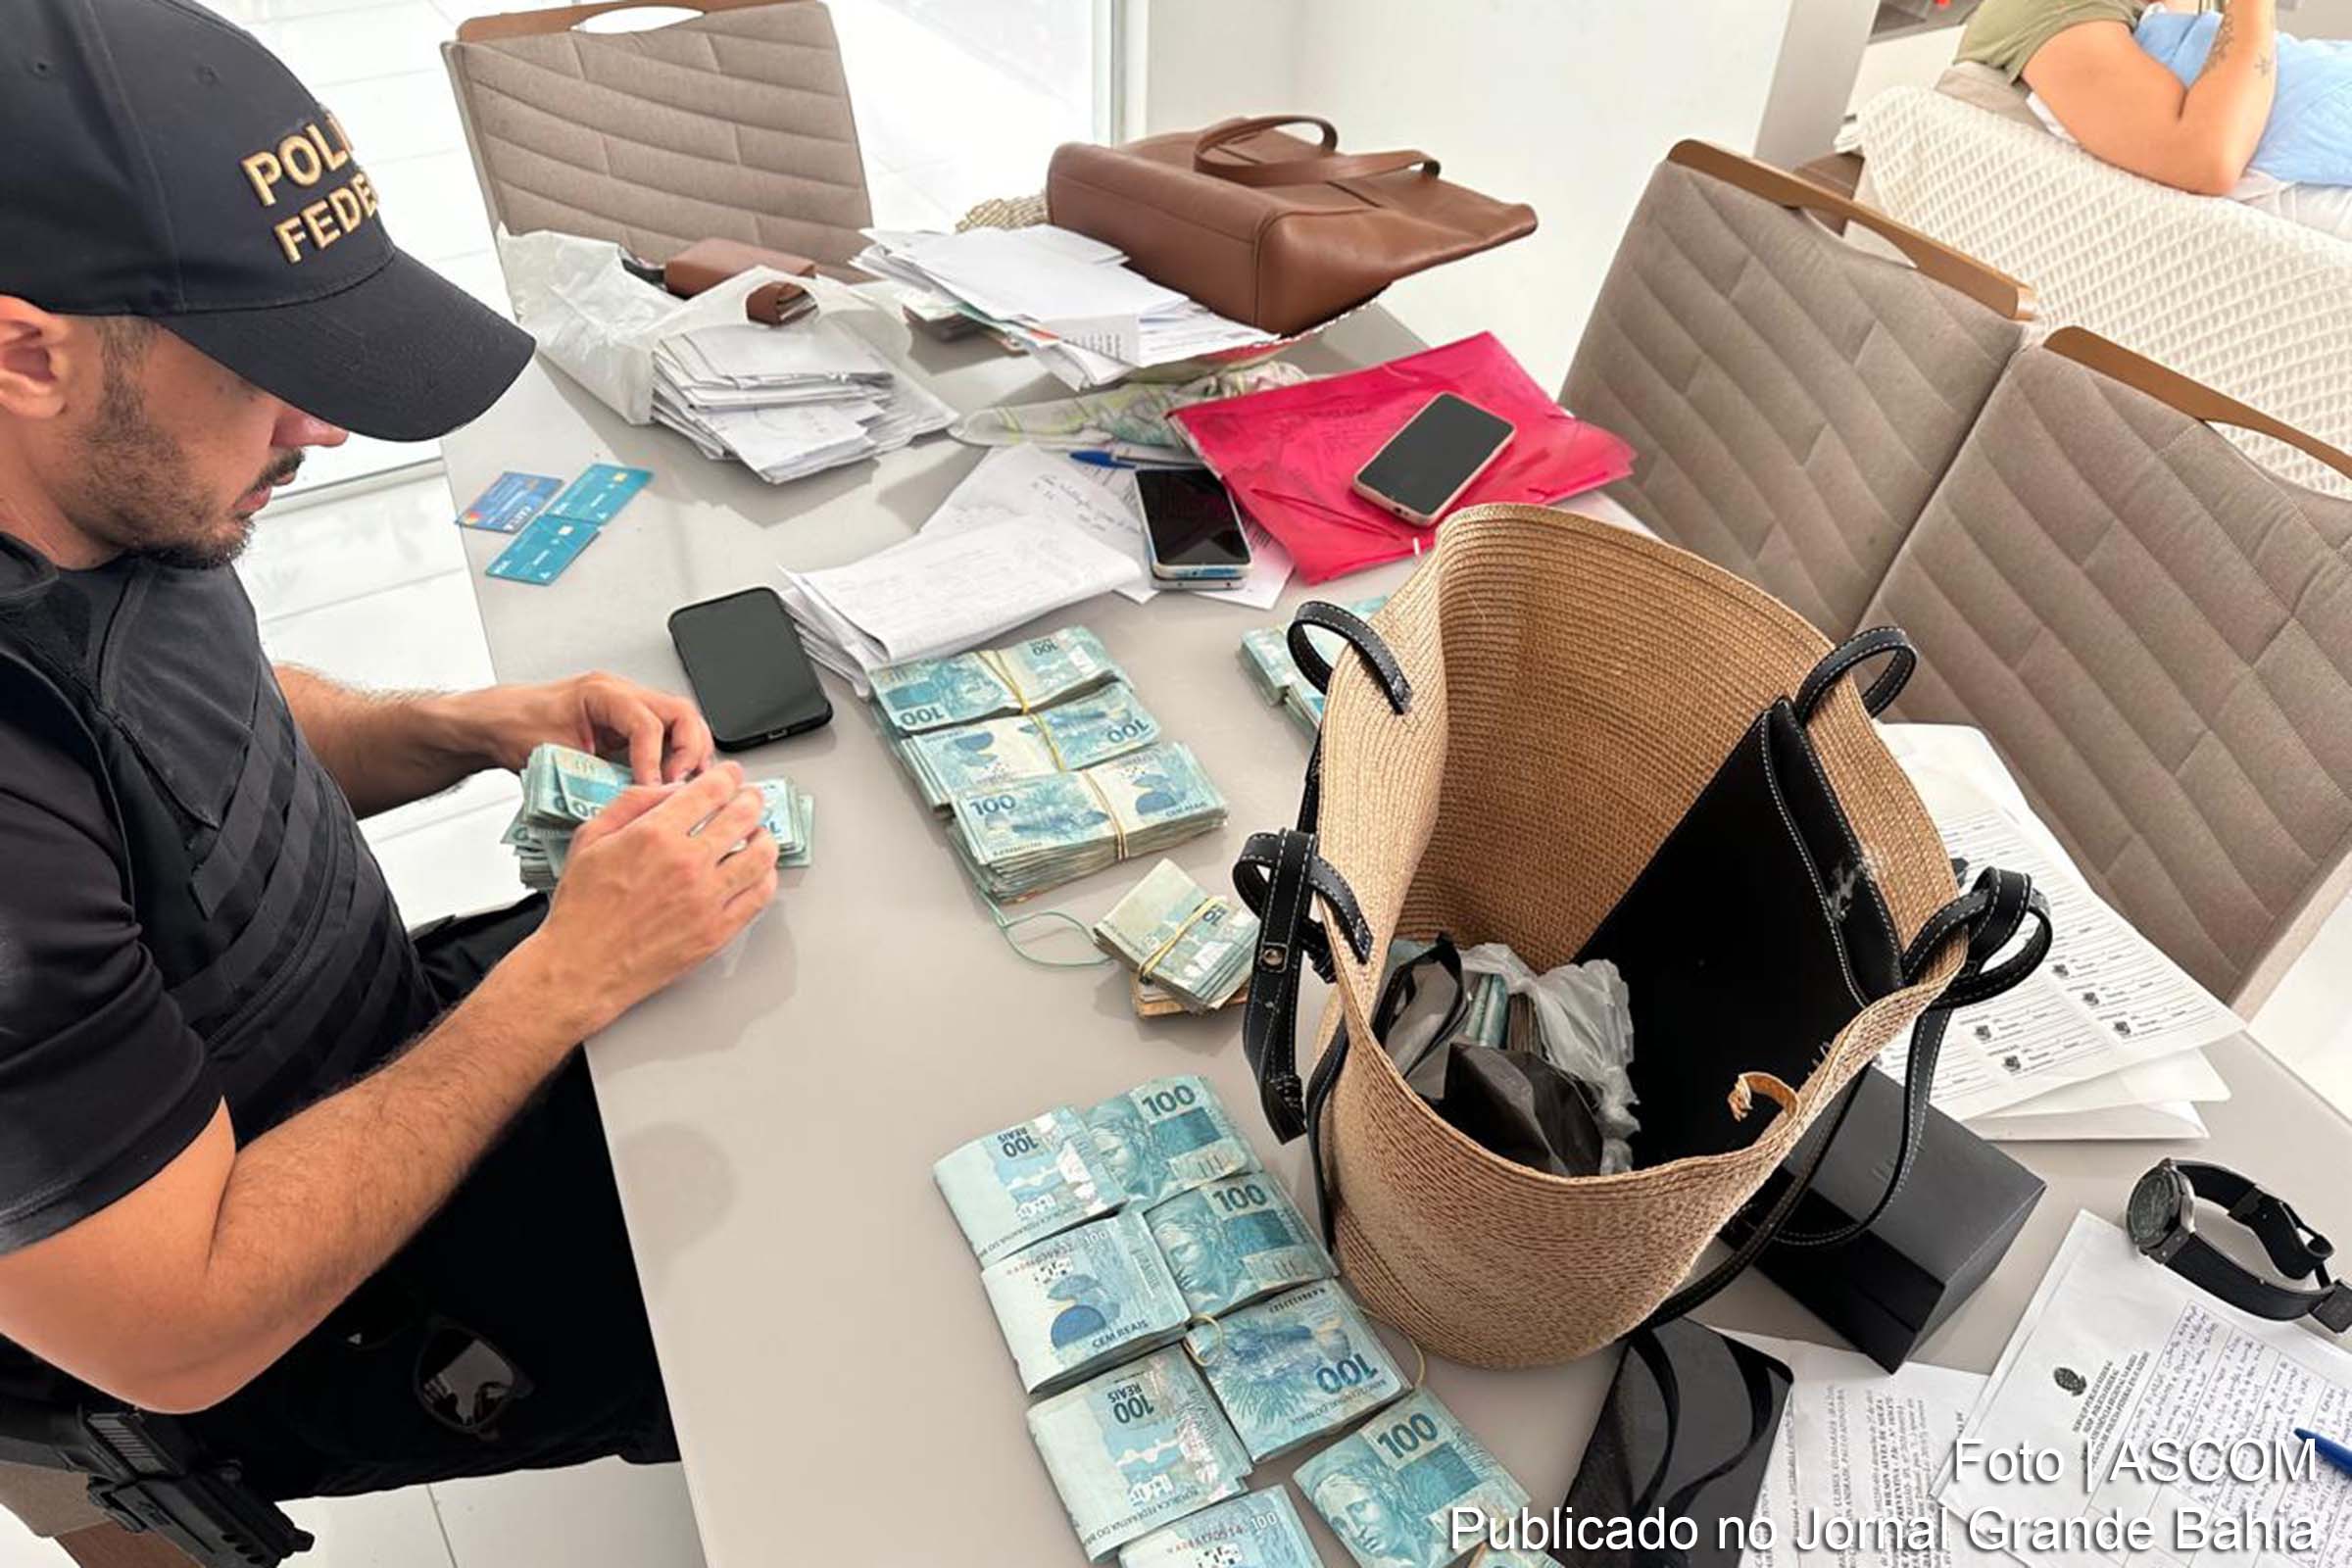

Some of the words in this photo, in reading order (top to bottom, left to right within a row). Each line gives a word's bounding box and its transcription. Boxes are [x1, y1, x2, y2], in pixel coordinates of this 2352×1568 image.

[901, 706, 945, 727] 100
[1107, 717, 1152, 744] 100
[970, 793, 1017, 817] 100
[1142, 1084, 1196, 1117] 100
[1003, 1138, 1039, 1158] 100
[1213, 1183, 1268, 1212] 100
[1092, 1334, 1115, 1348] CEM
[1116, 1320, 1149, 1341] REAIS
[1316, 1352, 1378, 1396] 100
[1107, 1382, 1143, 1403] REAIS
[1113, 1395, 1154, 1424] 100
[1377, 1412, 1439, 1459] 100
[1250, 1512, 1278, 1531] 100
